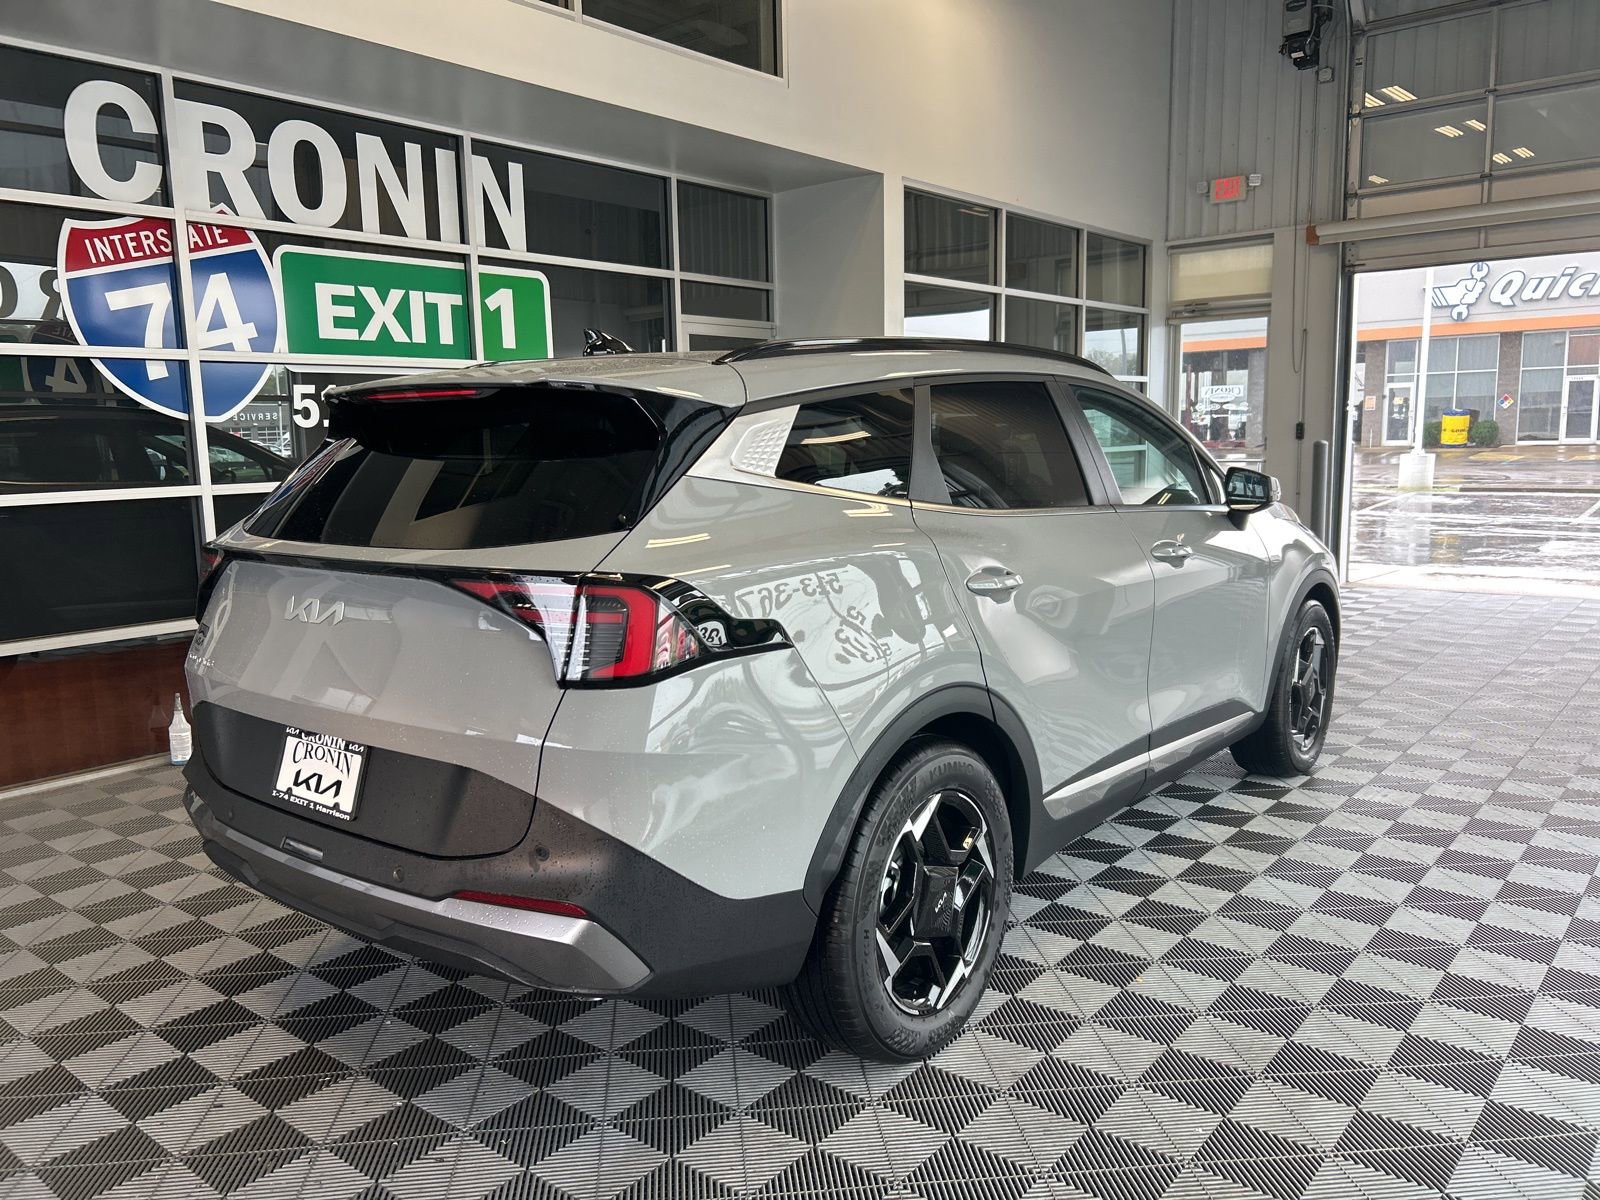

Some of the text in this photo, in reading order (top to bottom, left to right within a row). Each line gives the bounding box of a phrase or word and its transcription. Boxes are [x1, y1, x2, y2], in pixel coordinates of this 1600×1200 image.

[64, 80, 527, 252] CRONIN
[85, 224, 228, 264] INTERSATE
[104, 272, 258, 381] 74
[314, 282, 517, 349] EXIT 1
[284, 596, 345, 626] KIA
[286, 727, 300, 735] KIA
[348, 743, 364, 753] KIA
[293, 740, 353, 779] CRONIN
[293, 768, 342, 799] KIA
[272, 789, 350, 821] I-74 EXIT 1 Harrison
